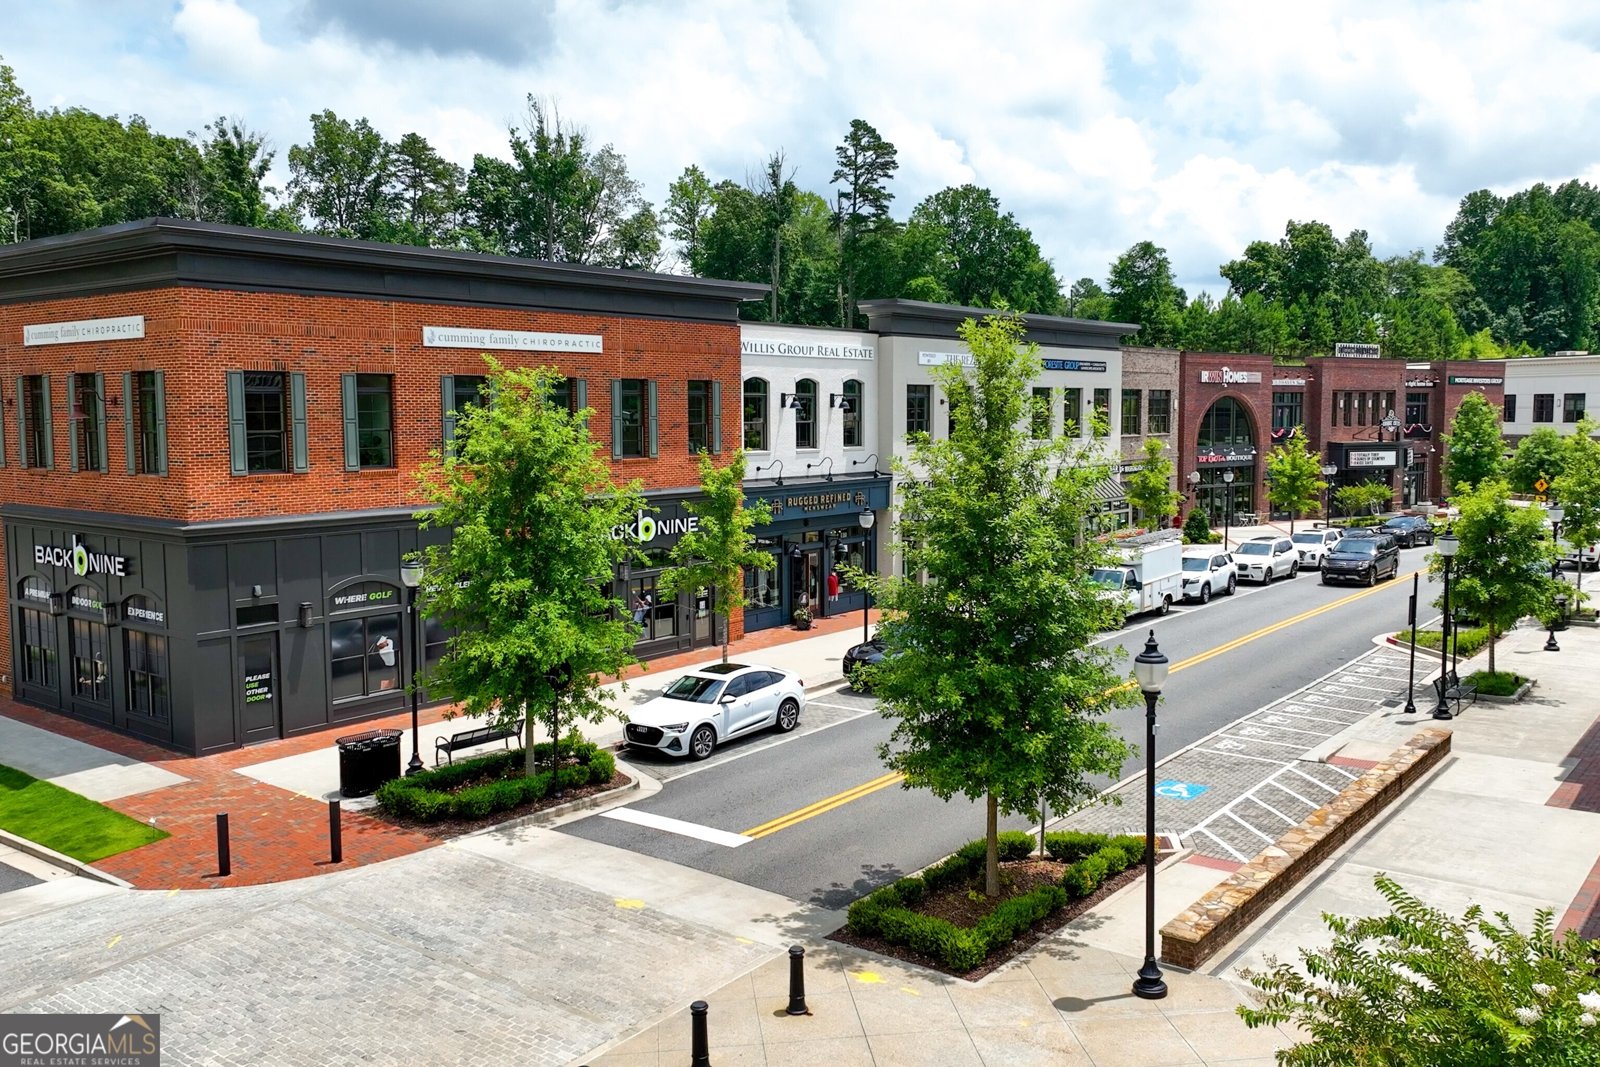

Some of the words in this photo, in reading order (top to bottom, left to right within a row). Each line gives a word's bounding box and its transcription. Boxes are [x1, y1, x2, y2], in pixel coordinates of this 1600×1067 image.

[31, 328, 59, 342] cumming
[60, 325, 79, 339] family
[82, 324, 140, 336] CHIROPRACTIC
[438, 333, 485, 346] cumming
[489, 333, 519, 348] family
[523, 338, 601, 349] CHIROPRACTIC
[778, 343, 814, 356] GROUP
[817, 345, 840, 357] REAL
[843, 347, 873, 358] ESTATE
[788, 495, 818, 507] RUGGED
[820, 492, 851, 504] REFINED
[658, 516, 699, 536] NINE
[34, 545, 73, 568] BACK
[89, 552, 126, 576] NINE
[92, 600, 104, 610] GOL
[334, 593, 368, 605] WHERE
[369, 590, 392, 600] GOLF
[128, 606, 164, 622] EXPERIENCE
[245, 672, 270, 682] PLEASE
[246, 687, 268, 696] OTHER
[246, 694, 266, 703] DOOR
